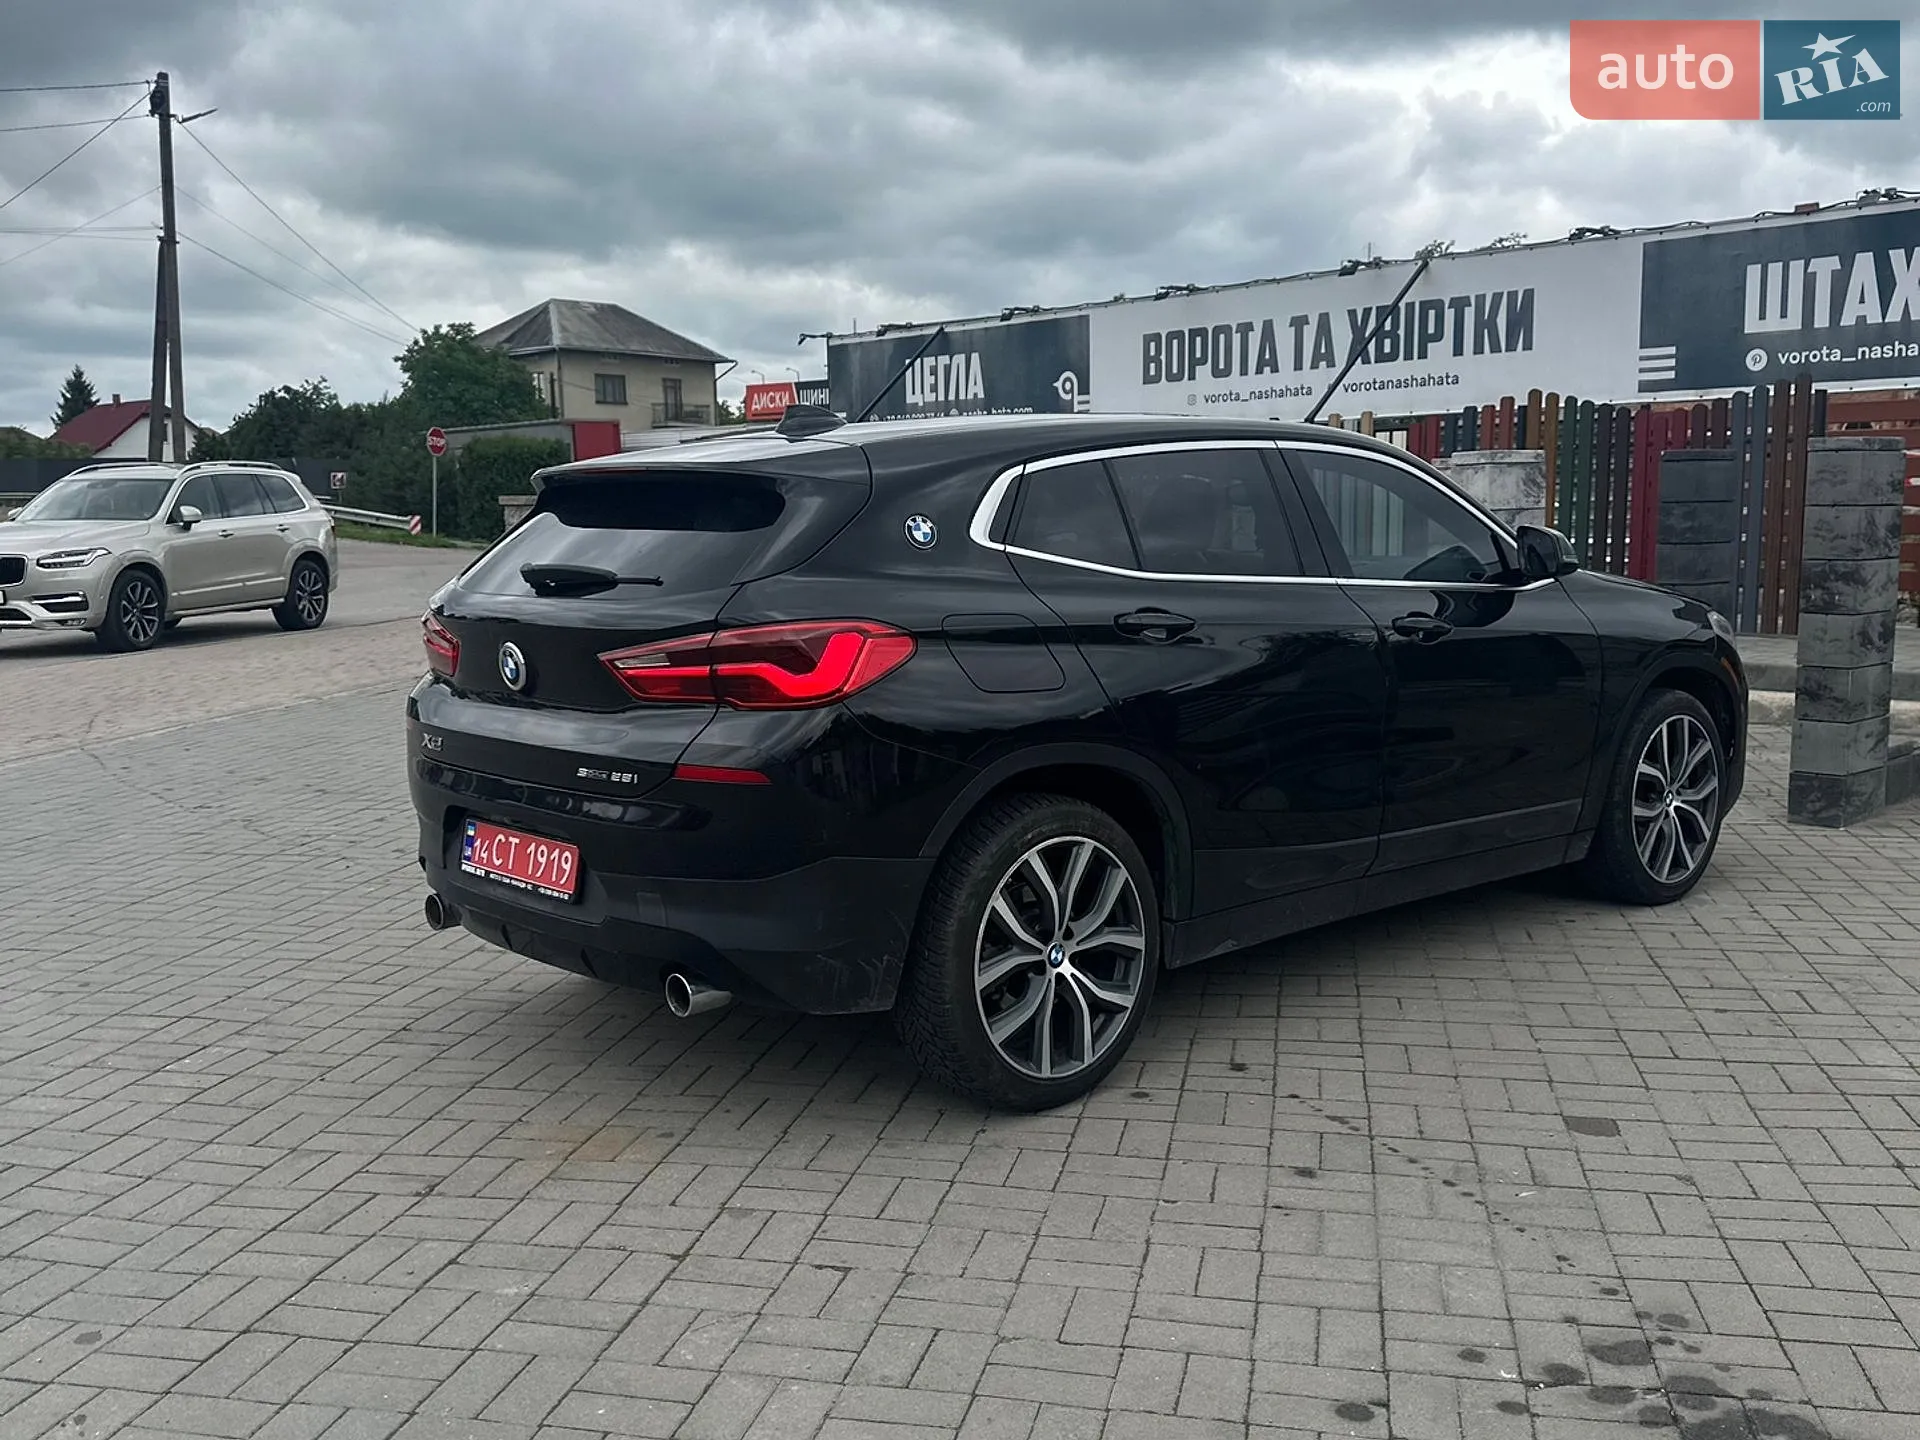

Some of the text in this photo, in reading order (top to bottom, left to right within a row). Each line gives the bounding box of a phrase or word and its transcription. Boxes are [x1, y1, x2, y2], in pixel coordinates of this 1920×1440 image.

[1744, 246, 1920, 334] ШТАХ
[1143, 288, 1535, 385] ВОРОТА ТА ХВІРТКИ
[1778, 341, 1919, 364] vorota_nasha
[905, 352, 984, 406] ЦЕГЛА
[1204, 384, 1312, 404] vorota_nashahata
[1343, 372, 1460, 393] vorotanashahata
[751, 388, 829, 412] ДИСКИ ШИН
[473, 834, 520, 870] 14CT
[526, 842, 572, 885] 1919
